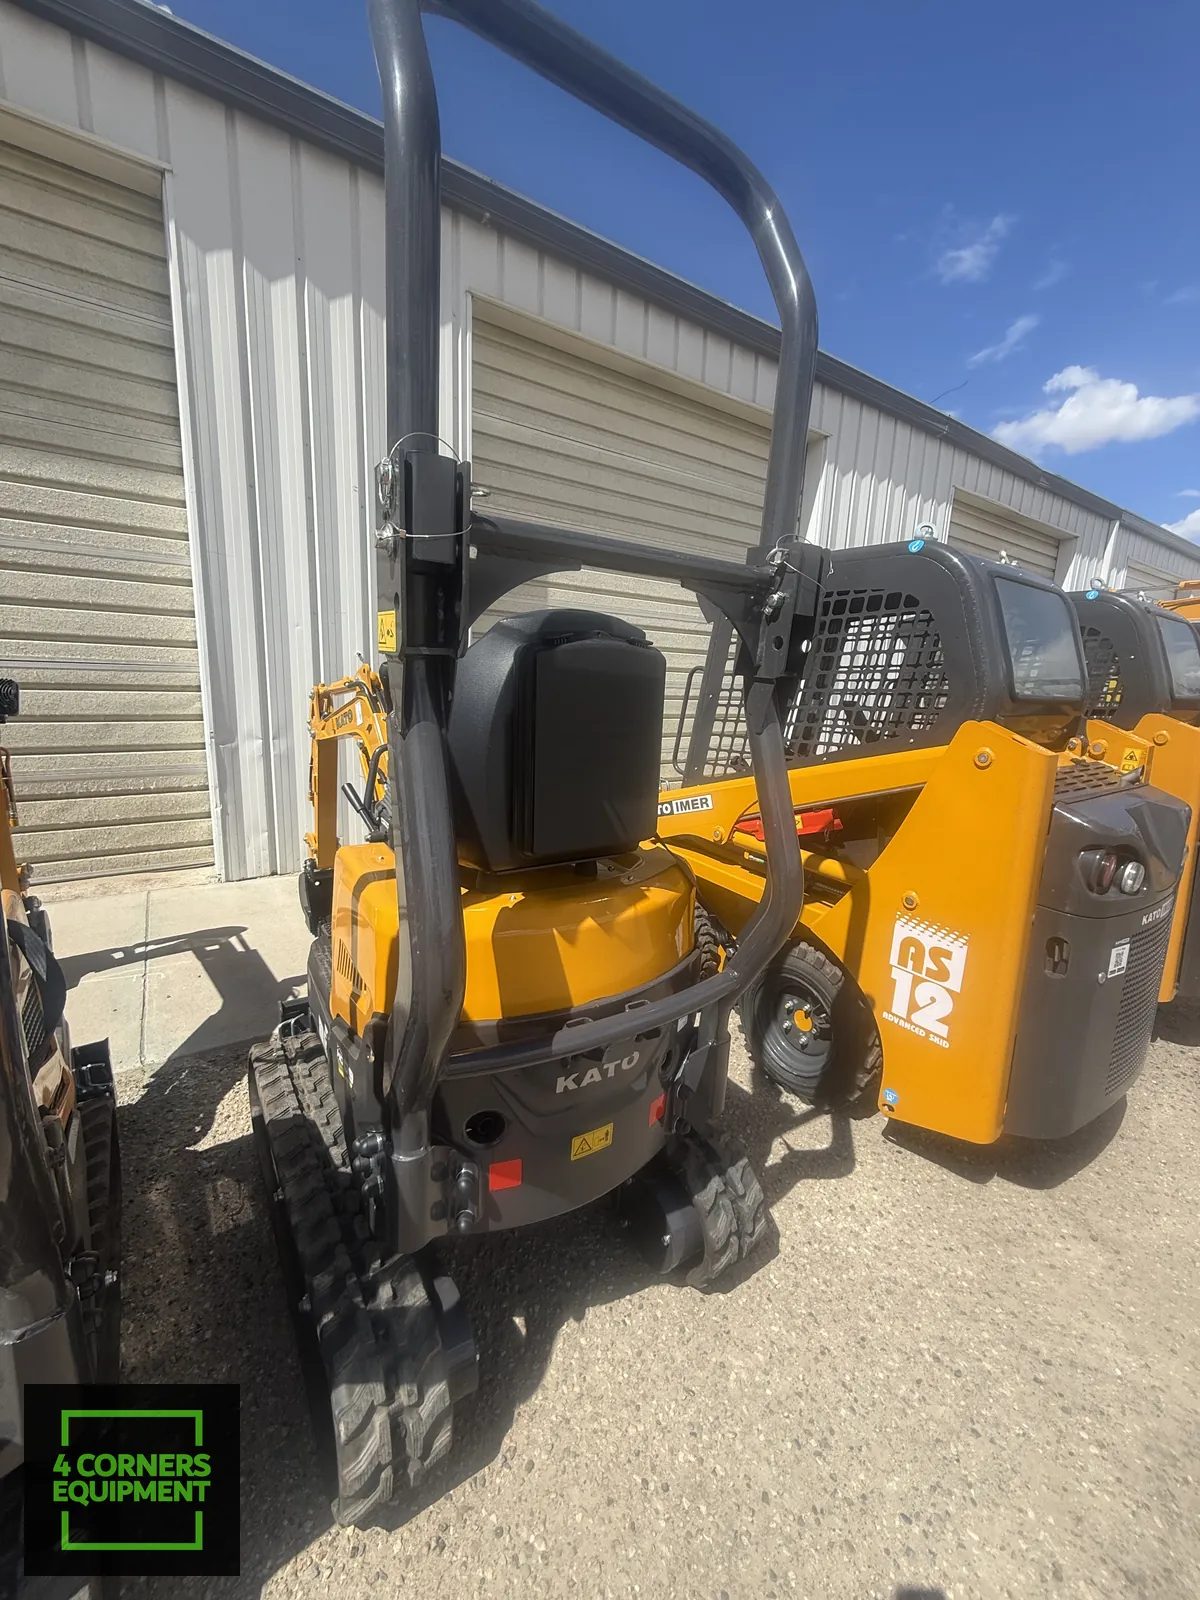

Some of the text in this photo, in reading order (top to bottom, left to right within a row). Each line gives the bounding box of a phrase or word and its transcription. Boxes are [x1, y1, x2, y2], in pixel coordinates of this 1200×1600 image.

[675, 797, 710, 813] IMER
[1142, 908, 1161, 925] KATO
[897, 936, 953, 983] AS
[890, 965, 954, 1039] 12
[882, 1011, 950, 1049] ADVANCED SKID
[555, 1051, 640, 1094] KATO
